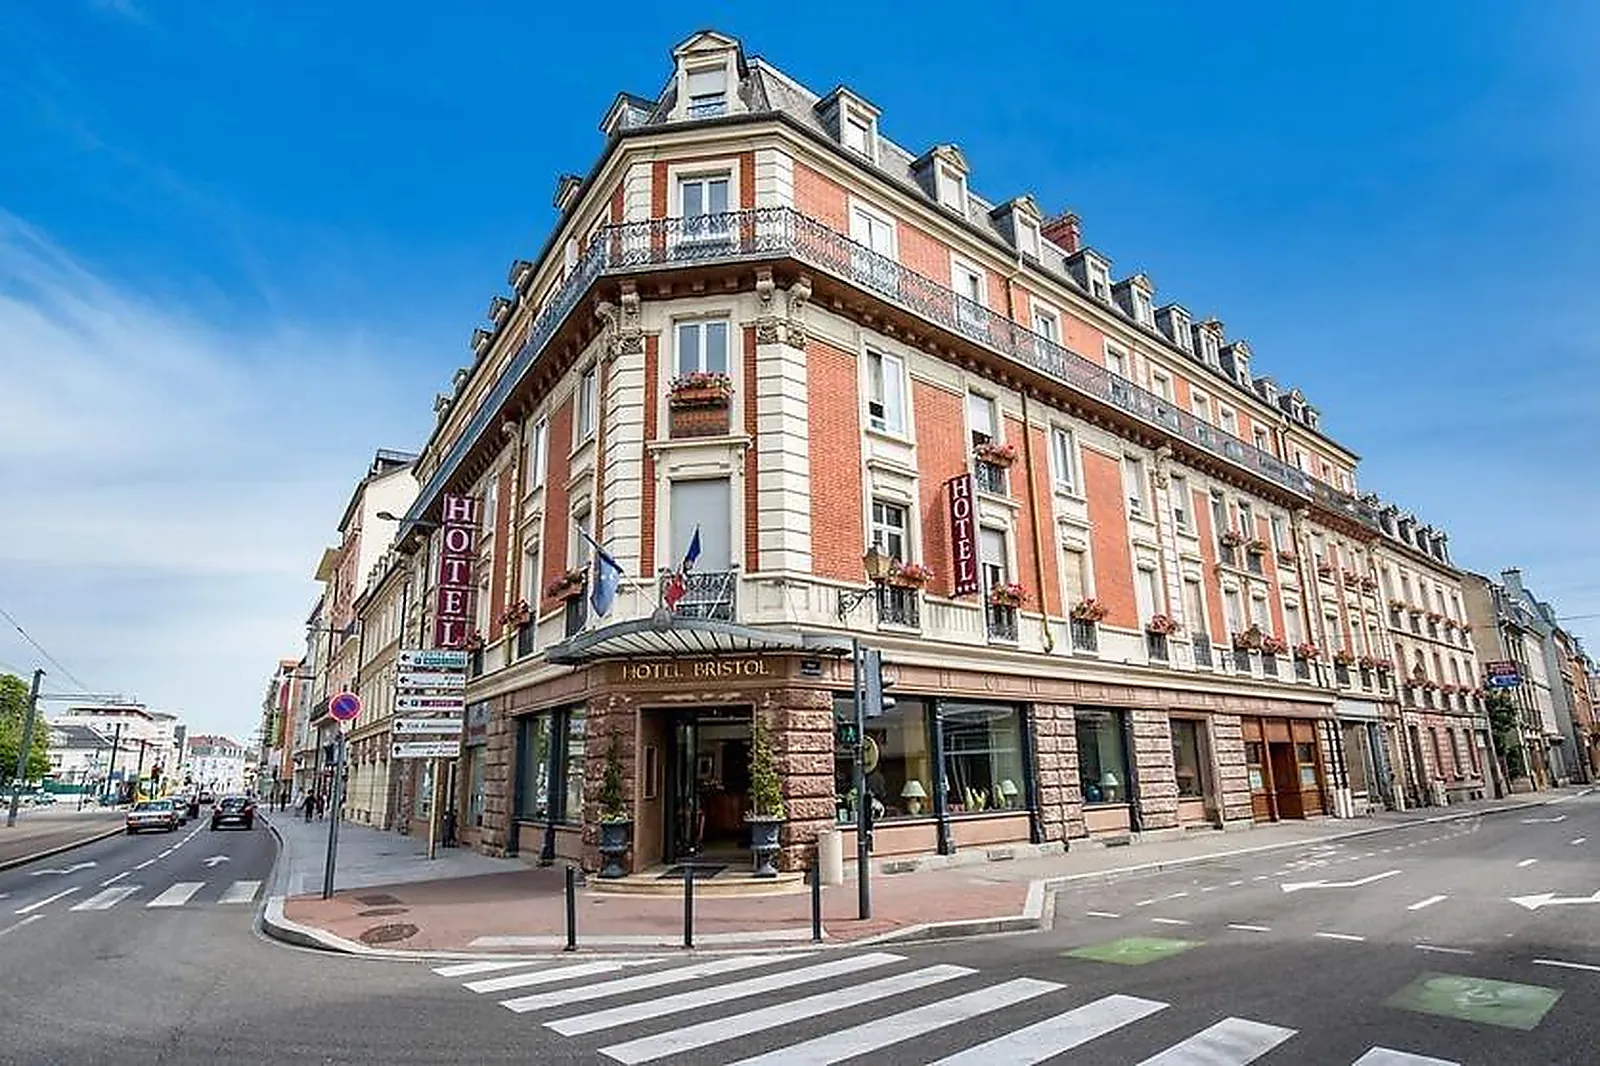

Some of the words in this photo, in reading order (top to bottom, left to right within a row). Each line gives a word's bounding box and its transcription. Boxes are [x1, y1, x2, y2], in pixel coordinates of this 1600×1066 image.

[443, 497, 472, 647] HOTEL
[952, 476, 973, 581] HOTEL
[622, 663, 684, 680] HOTEL
[693, 659, 769, 677] BRISTOL
